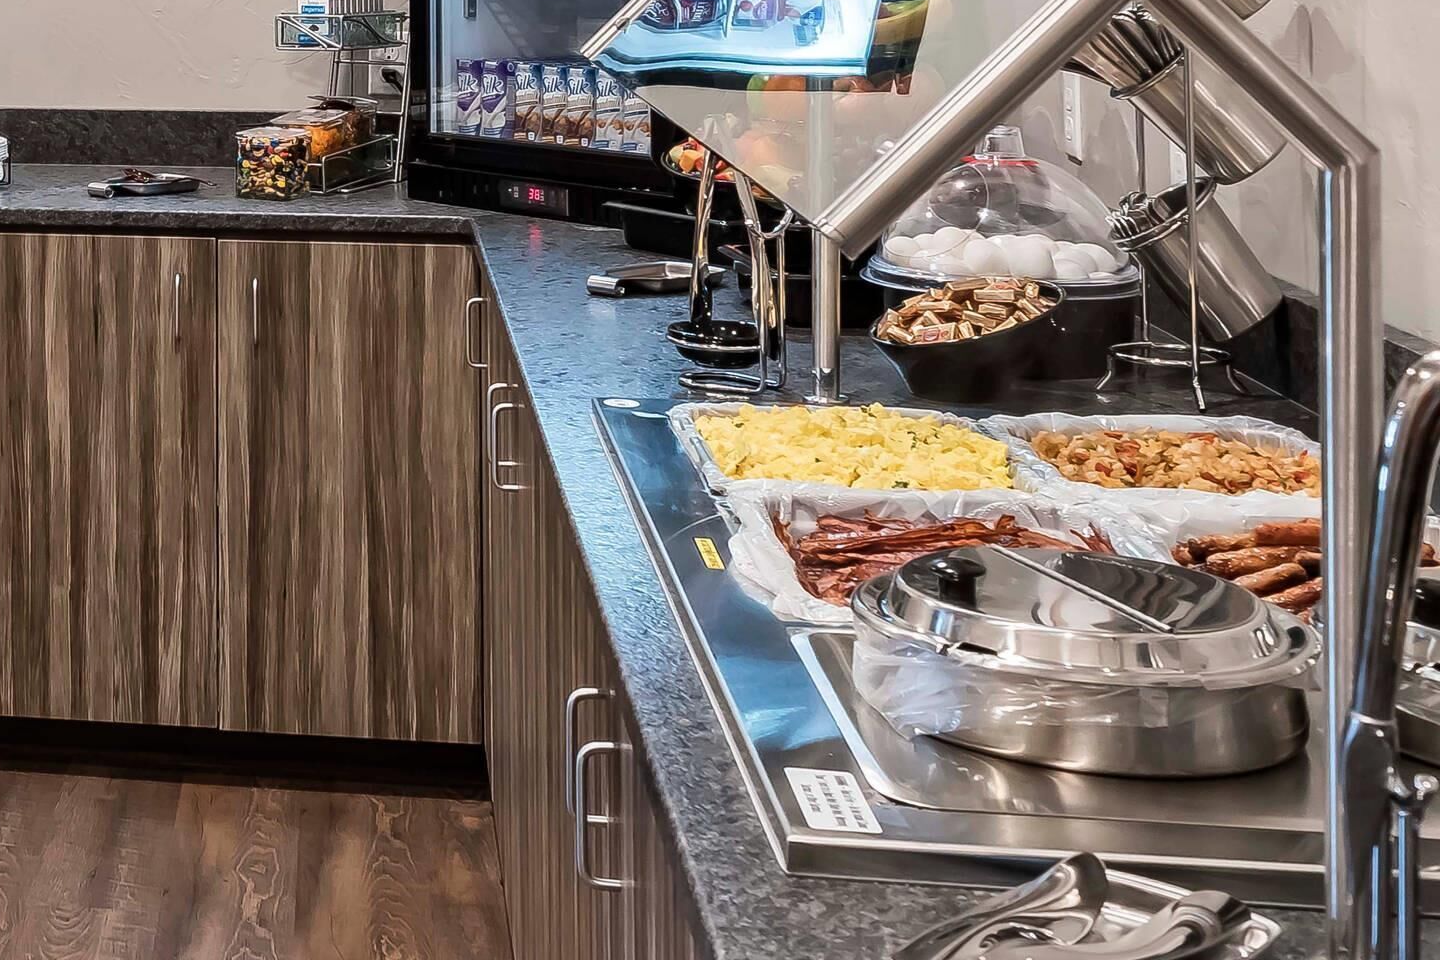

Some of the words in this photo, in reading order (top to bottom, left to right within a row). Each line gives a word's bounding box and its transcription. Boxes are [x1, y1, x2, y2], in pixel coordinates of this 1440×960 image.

[543, 76, 564, 95] Silk
[567, 78, 591, 97] Silk
[596, 80, 620, 100] Silk
